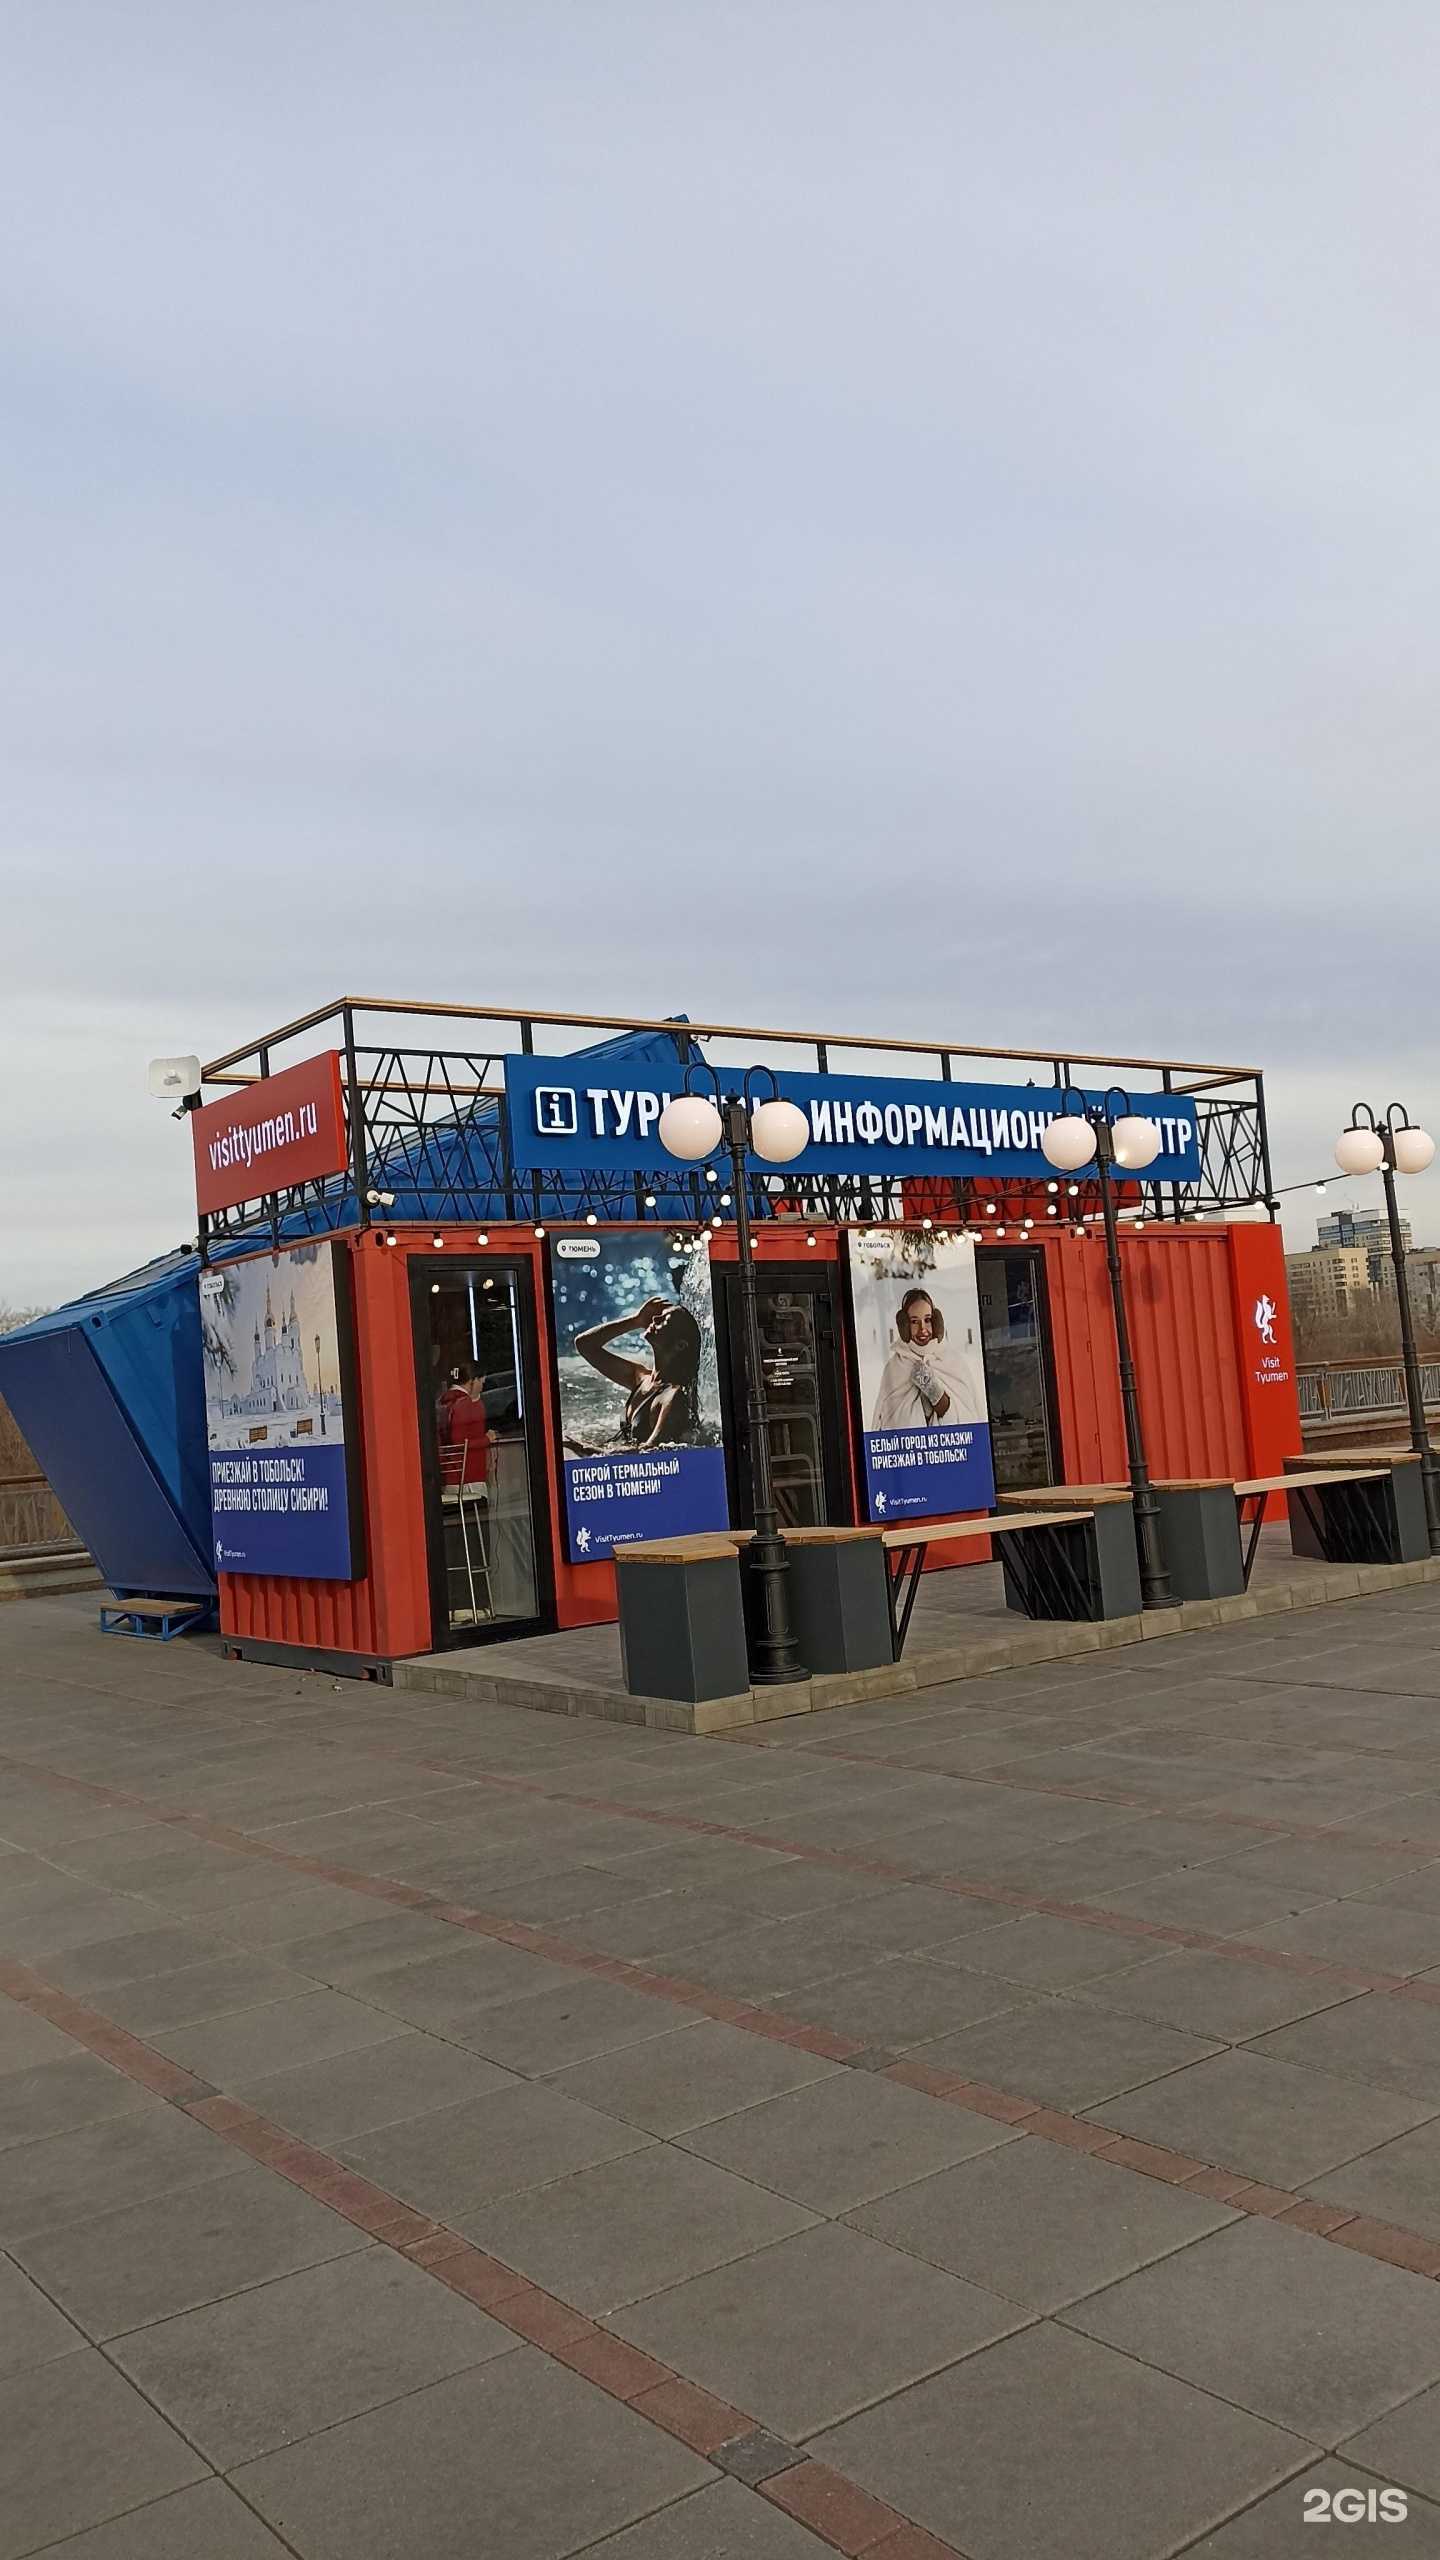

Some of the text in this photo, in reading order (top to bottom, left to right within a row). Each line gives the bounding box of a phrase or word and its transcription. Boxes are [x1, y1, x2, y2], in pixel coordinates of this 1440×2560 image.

[208, 1101, 318, 1170] visittyumen.ru
[811, 1099, 1105, 1156] ИНФОРМАЦИОН
[1262, 1357, 1280, 1368] Visit
[1255, 1371, 1288, 1384] Tyumen
[870, 1431, 973, 1453] БЕЛЫЙ ГОРОД ИЗ СКАЗКИ!
[871, 1448, 967, 1470] ПРИЕЗЖАЙ В ТОБОЛЬСК!
[212, 1457, 305, 1484] ПРИЕЗЖАЙ В ТОБОЛЬСК!
[572, 1458, 680, 1484] ОТКРОЙ ТЕРМАЛЬНЫЙ
[214, 1487, 328, 1513] ДРЕВНЮЮ СТОЛИЦУ СИБИРИ!
[573, 1480, 661, 1502] СЕЗОН В ТЮМЕНИ!
[594, 1532, 644, 1545] VisitTyumen.ru
